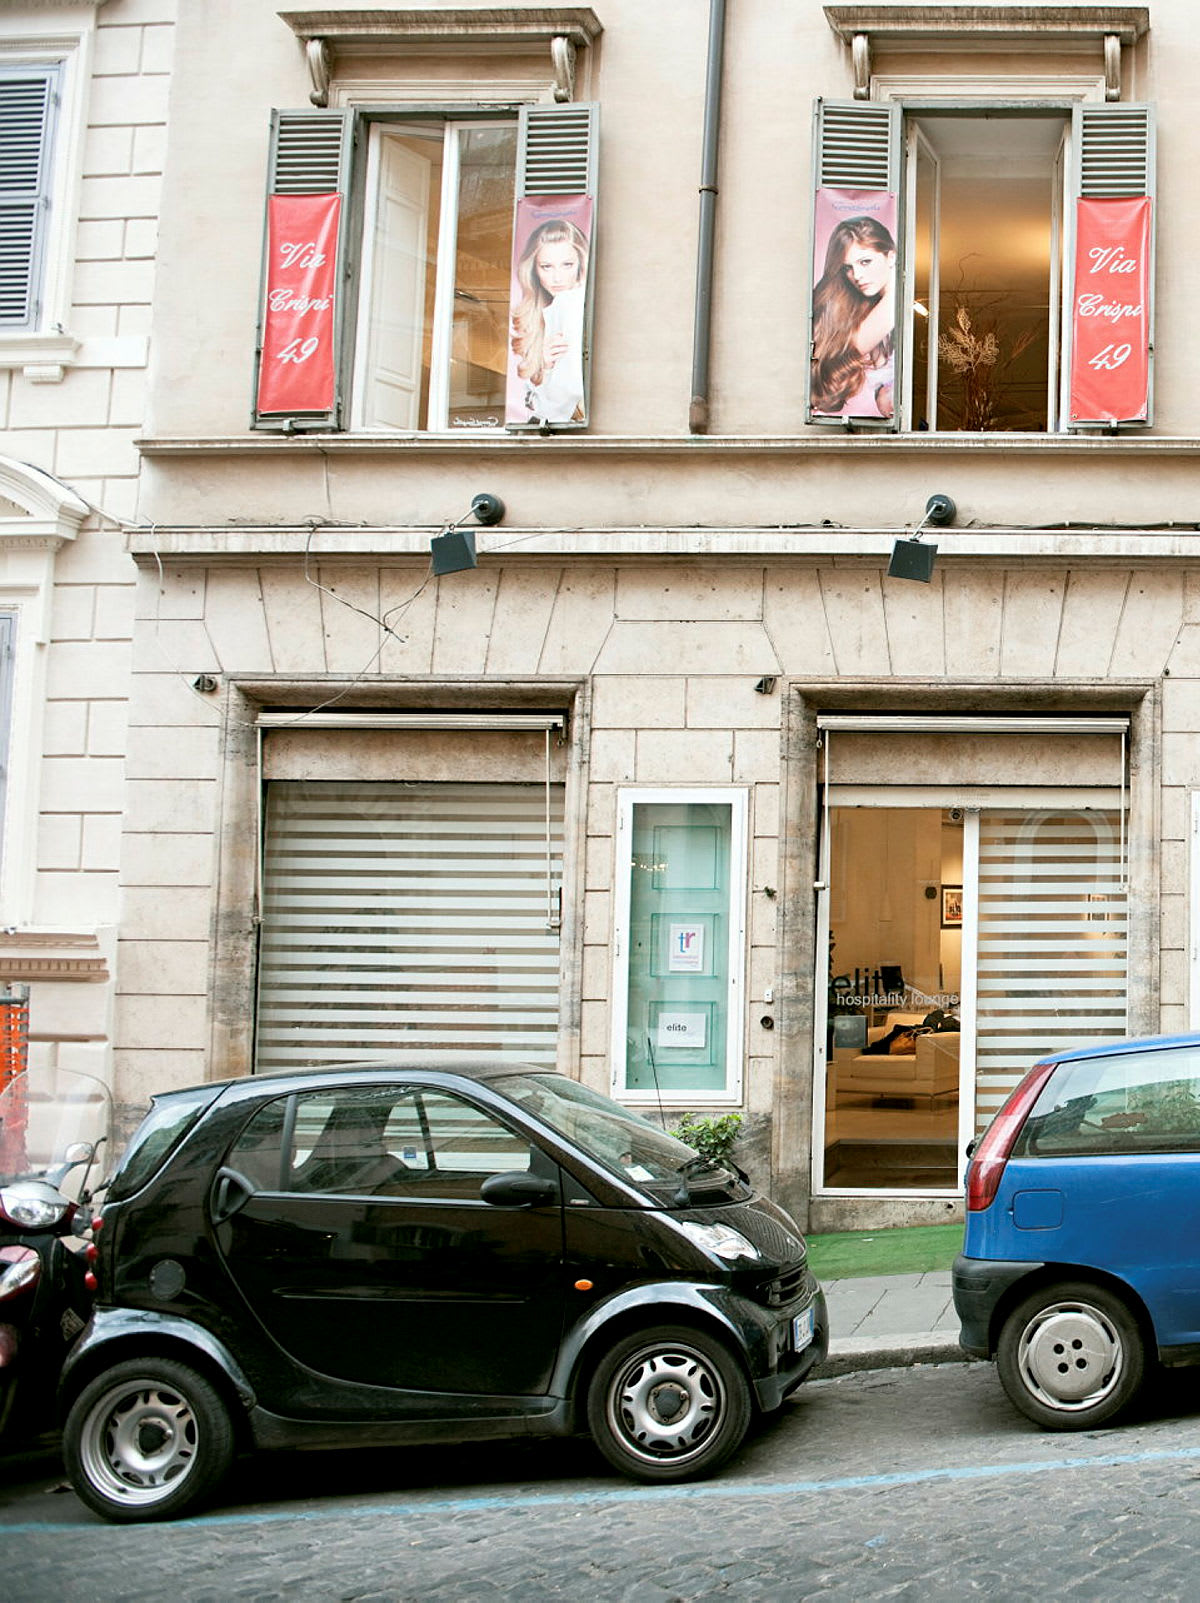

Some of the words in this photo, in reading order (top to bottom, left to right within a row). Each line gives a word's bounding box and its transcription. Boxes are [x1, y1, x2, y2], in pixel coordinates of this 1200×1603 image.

[279, 242, 326, 269] Via
[1089, 247, 1136, 274] Via
[268, 289, 332, 318] Crispi
[1077, 294, 1145, 323] Crispi
[276, 337, 319, 364] 49
[1088, 343, 1132, 370] 49
[836, 991, 907, 1008] hospitality
